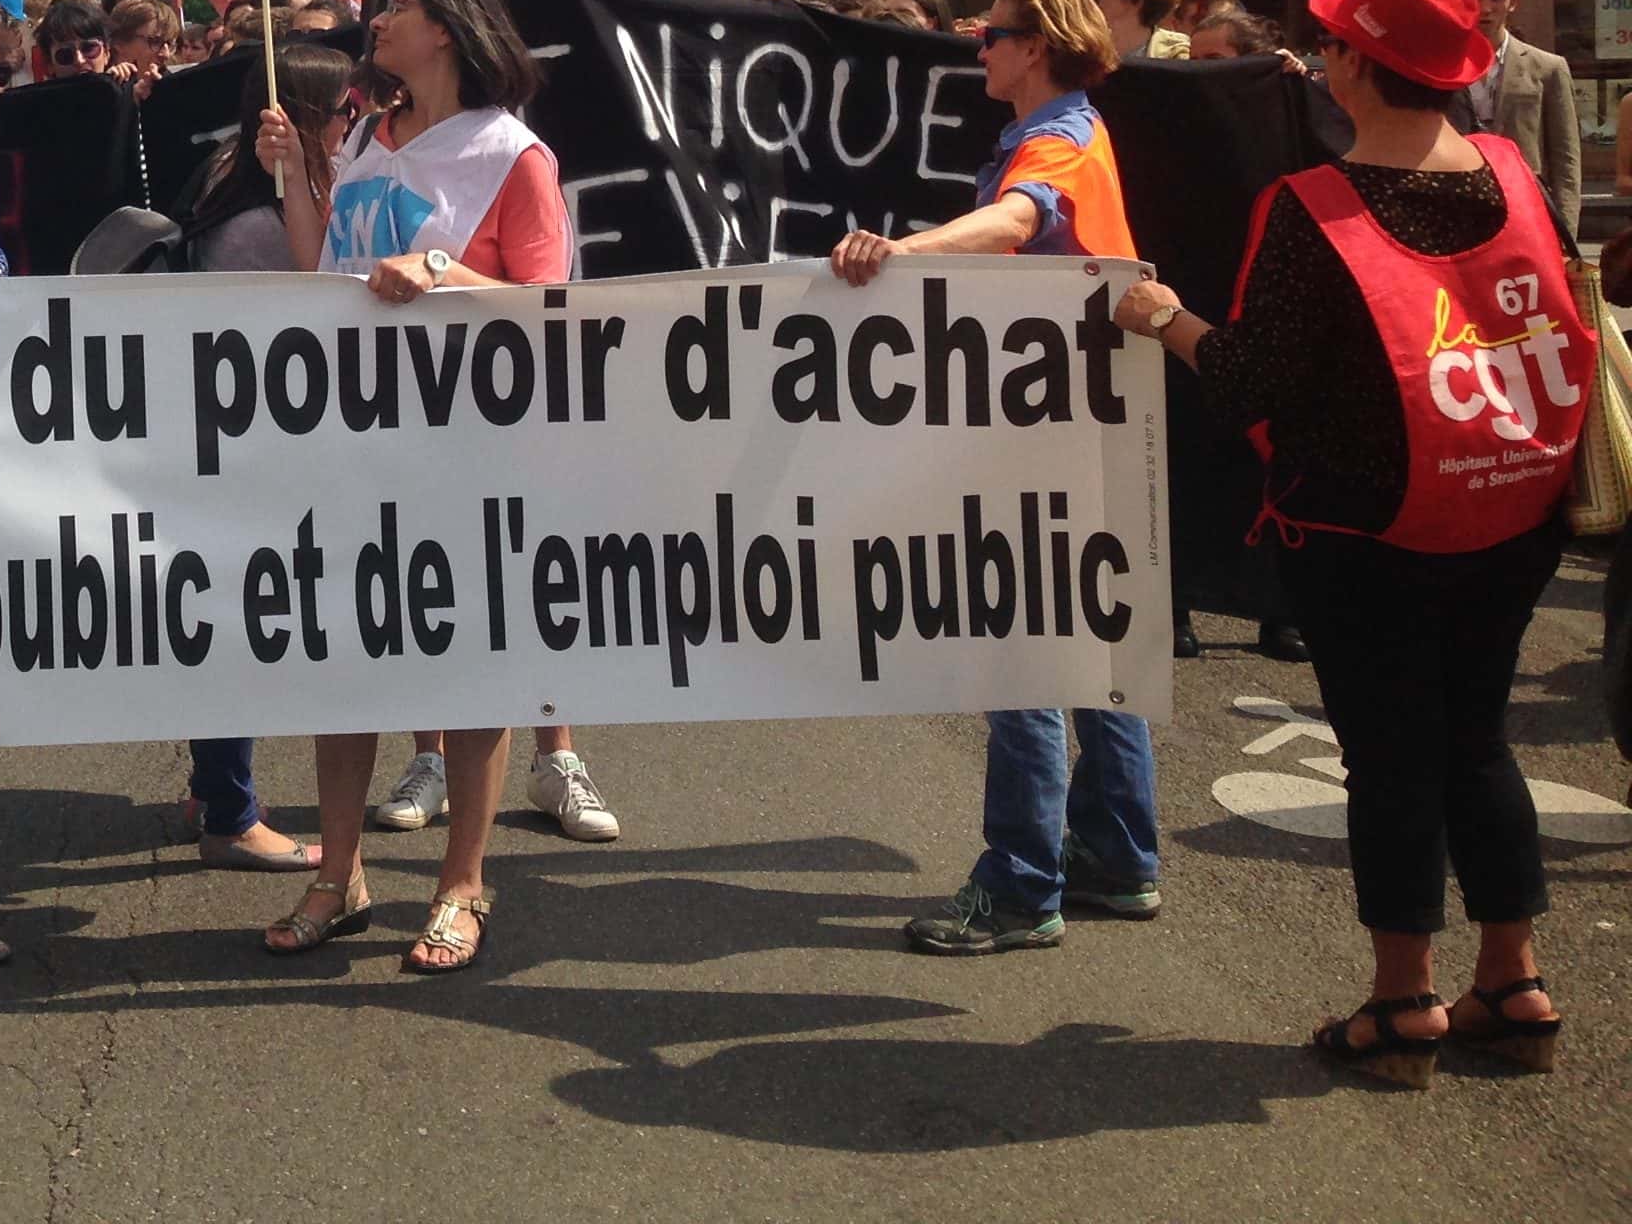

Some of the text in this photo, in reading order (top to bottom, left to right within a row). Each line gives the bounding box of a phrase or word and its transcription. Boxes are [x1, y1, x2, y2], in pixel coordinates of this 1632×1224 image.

[1496, 273, 1539, 316] 67
[10, 298, 147, 444] du
[192, 289, 626, 475] pouvoir
[664, 277, 1127, 427] d'achat
[1429, 313, 1581, 441] cgt
[1439, 455, 1497, 475] Hôpitaux
[1467, 476, 1485, 490] de
[243, 506, 329, 664] et
[354, 501, 456, 660] de
[482, 492, 822, 688] l'emploi
[853, 491, 1133, 682] public
